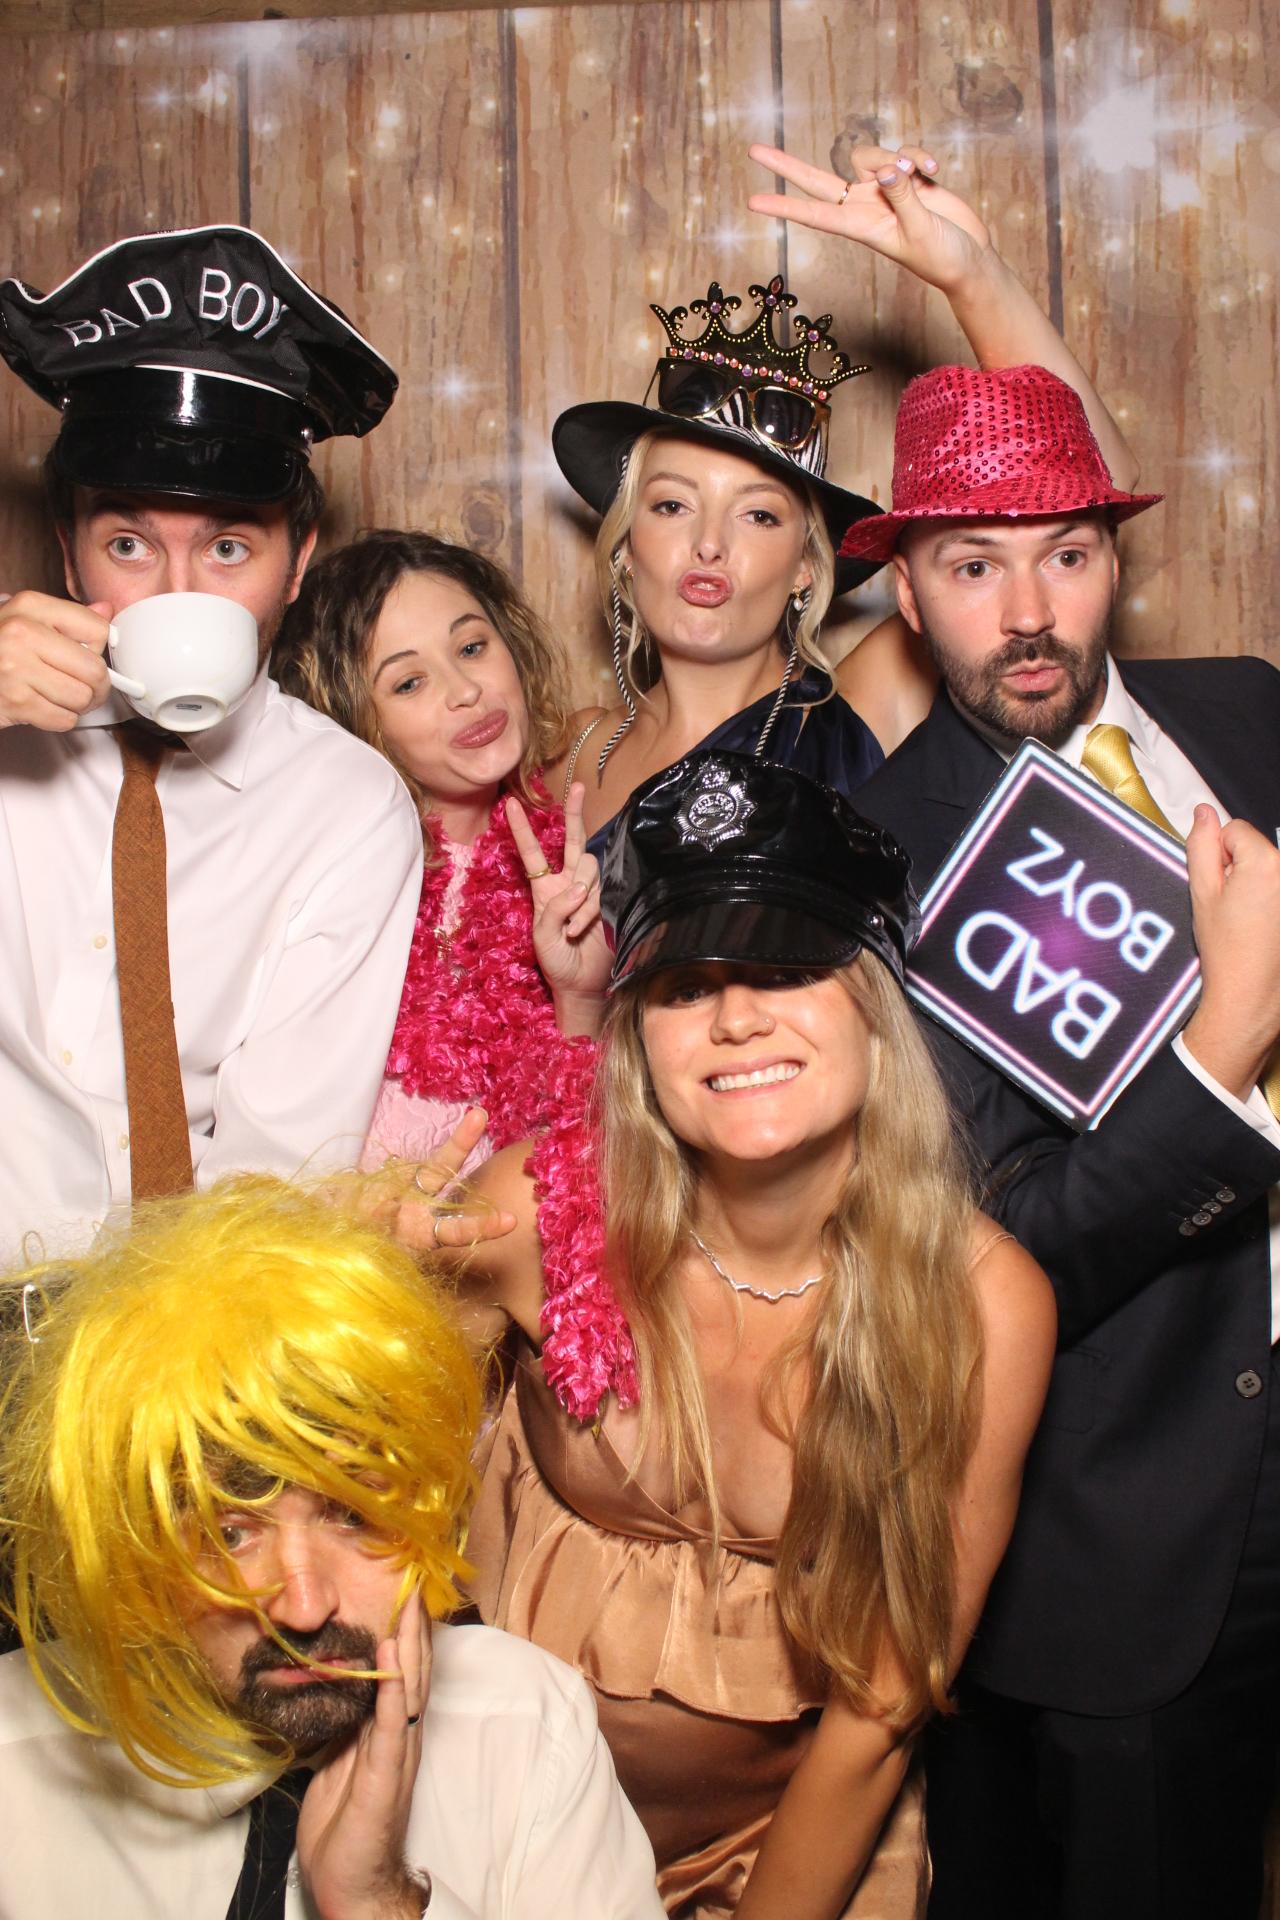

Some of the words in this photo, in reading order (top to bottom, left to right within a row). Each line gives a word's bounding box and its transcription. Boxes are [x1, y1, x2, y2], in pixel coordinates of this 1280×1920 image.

[54, 278, 172, 347] BAD
[199, 267, 290, 340] BOY
[1006, 828, 1175, 973] BOYZ
[955, 911, 1122, 1060] BAD
